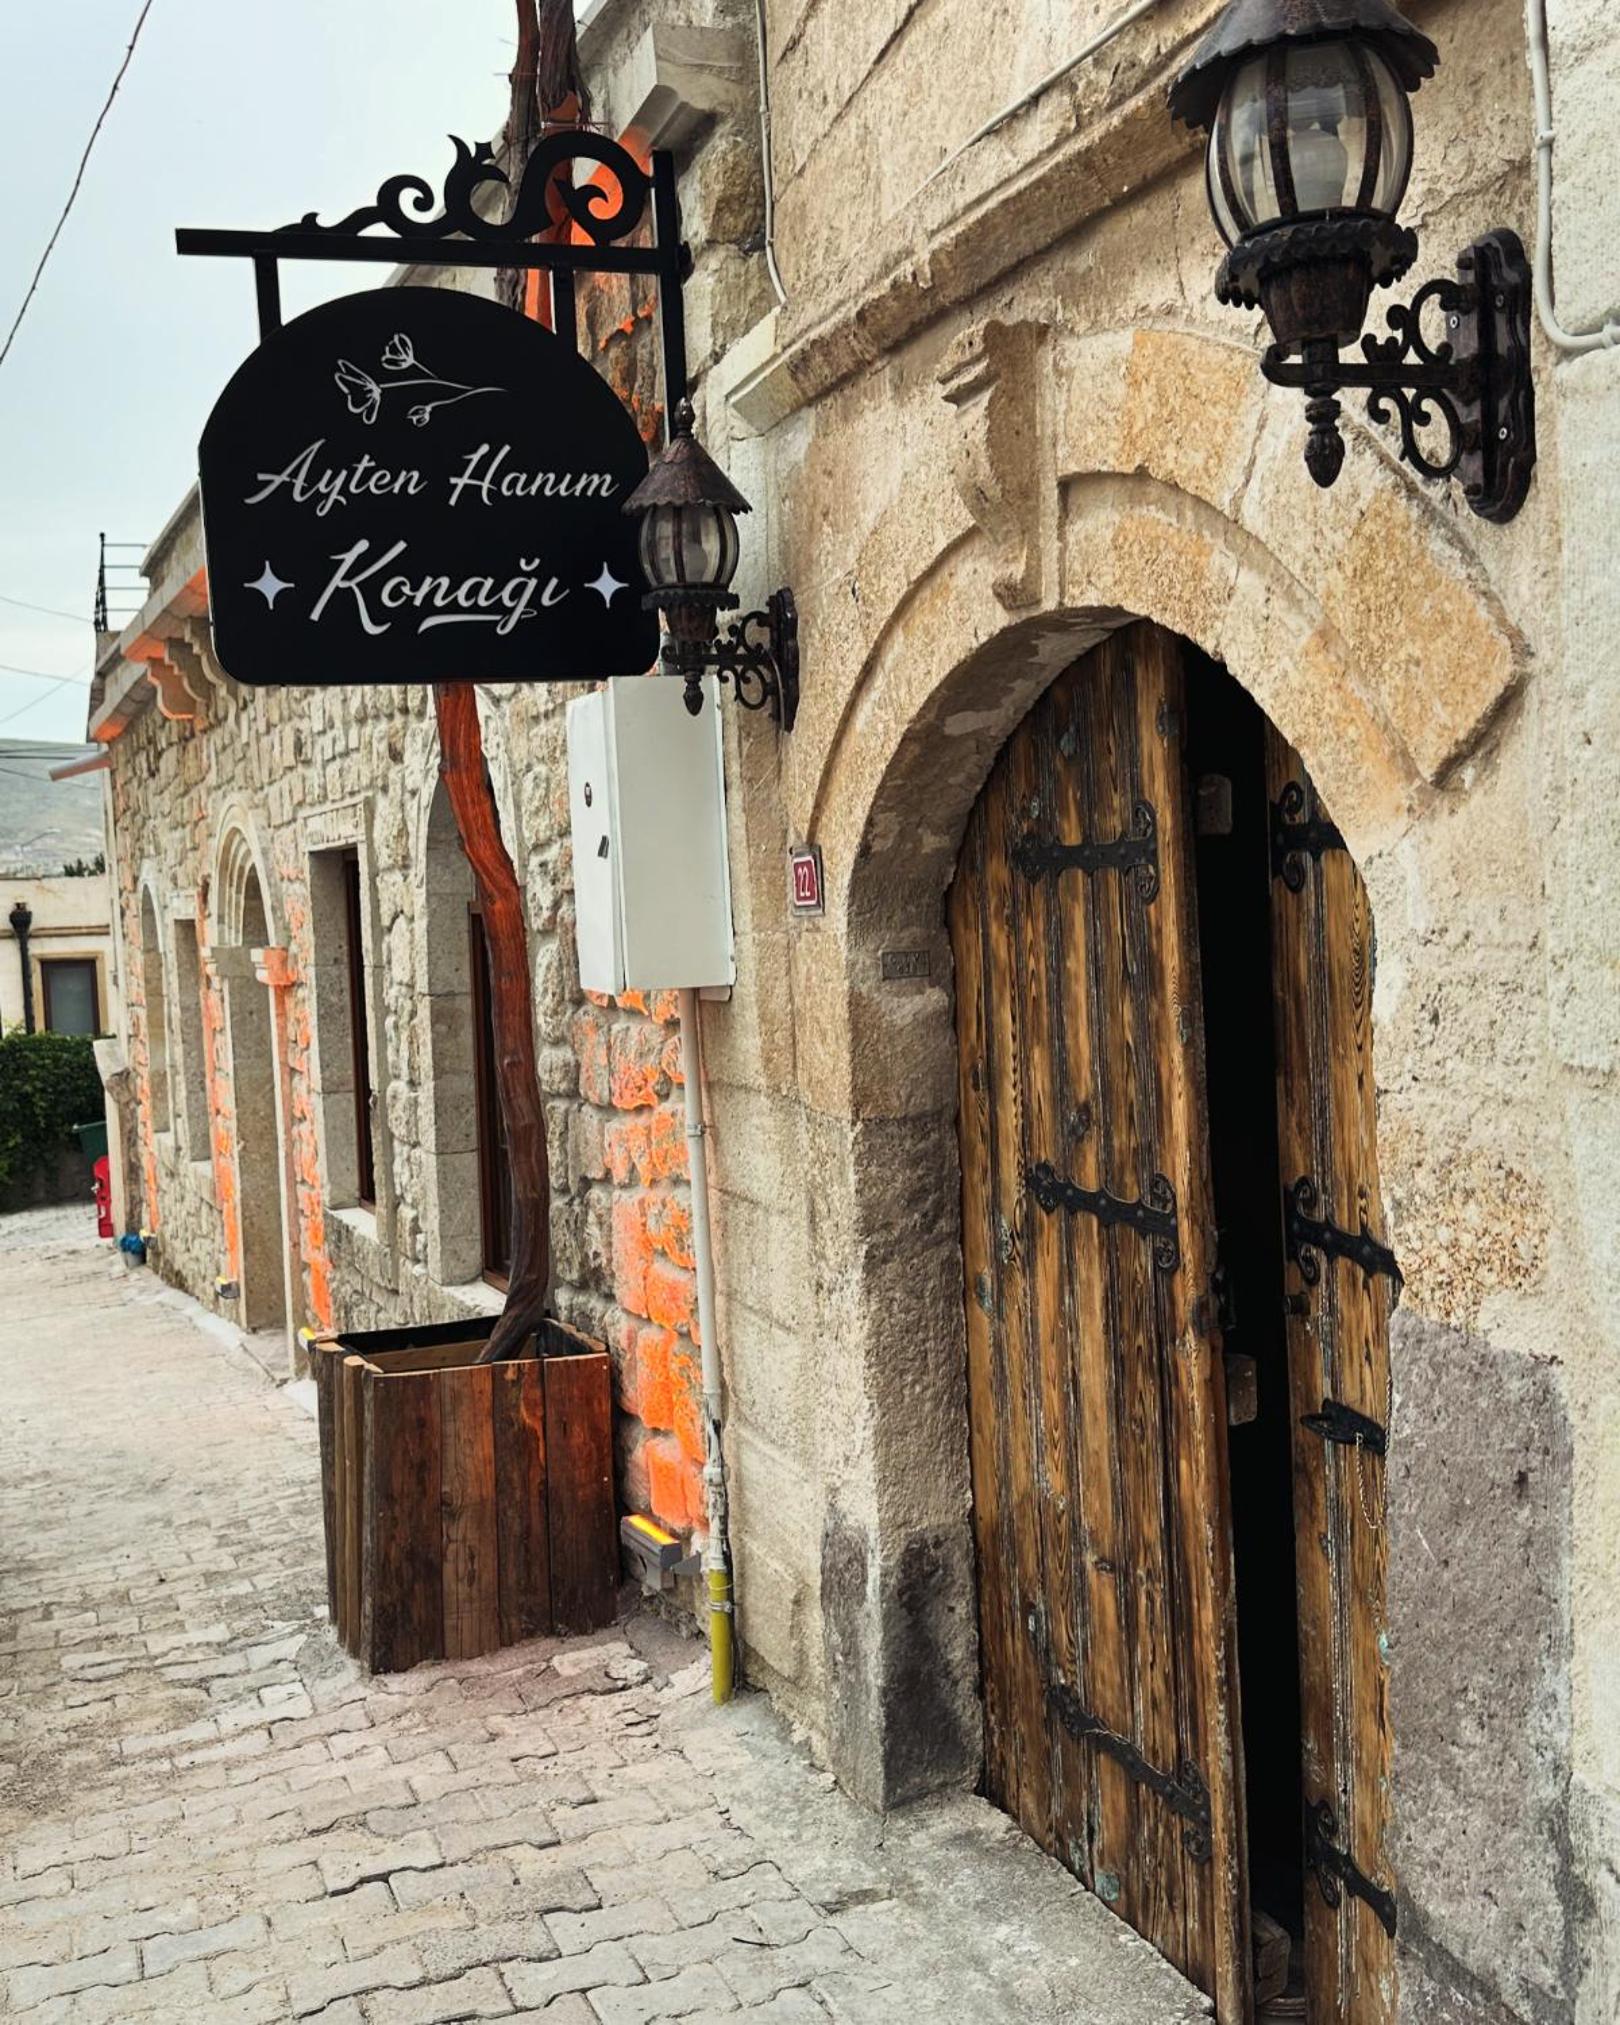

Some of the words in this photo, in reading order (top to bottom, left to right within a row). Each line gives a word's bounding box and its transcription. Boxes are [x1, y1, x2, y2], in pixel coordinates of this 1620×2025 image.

[243, 438, 427, 518] Ayten
[448, 443, 618, 507] Hanım
[309, 538, 571, 636] Konağı
